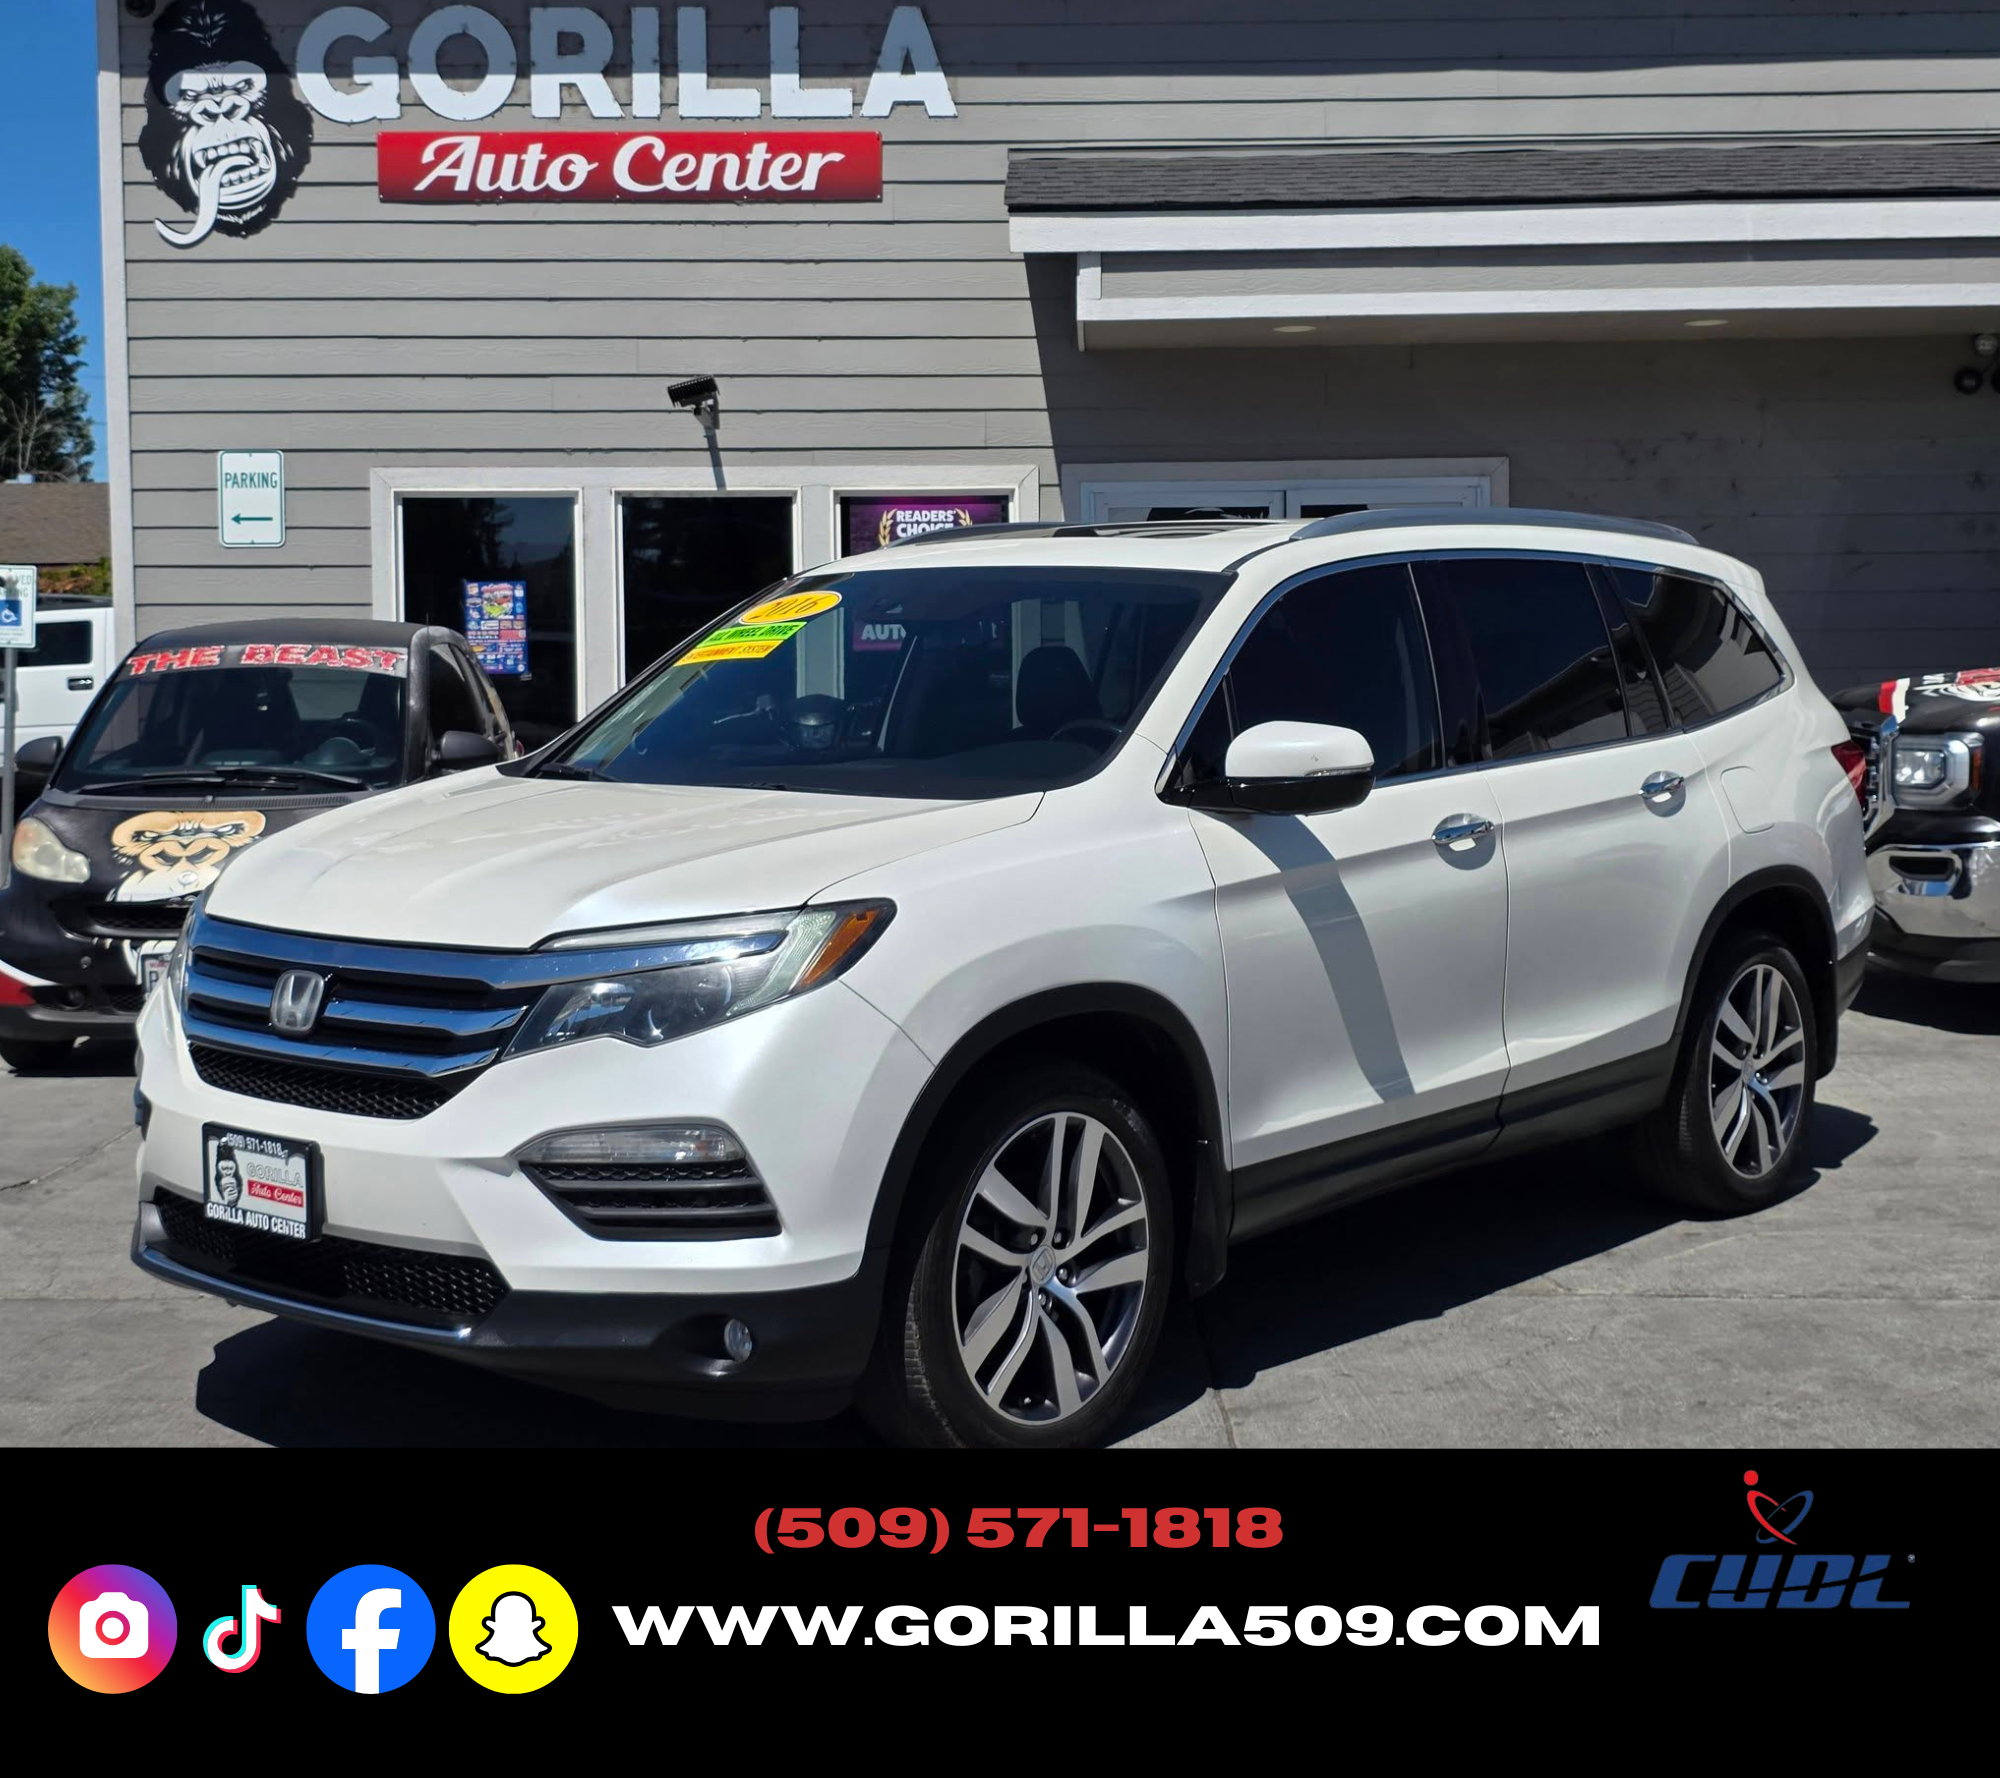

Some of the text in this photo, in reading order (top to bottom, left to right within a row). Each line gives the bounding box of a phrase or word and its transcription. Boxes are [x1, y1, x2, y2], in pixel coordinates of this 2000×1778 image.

[295, 5, 958, 124] GORILLA
[414, 136, 845, 193] Auto Center
[225, 472, 278, 489] PARKING
[896, 510, 957, 522] READERS'
[896, 523, 954, 538] CHOI
[762, 625, 801, 638] DRIVE
[126, 643, 407, 675] THE BEAST
[226, 1132, 282, 1156] (509) 571-1818
[246, 1161, 304, 1188] GORILLA
[251, 1182, 302, 1204] Auto Center
[207, 1202, 306, 1239] GORILLA AUTO CENTER
